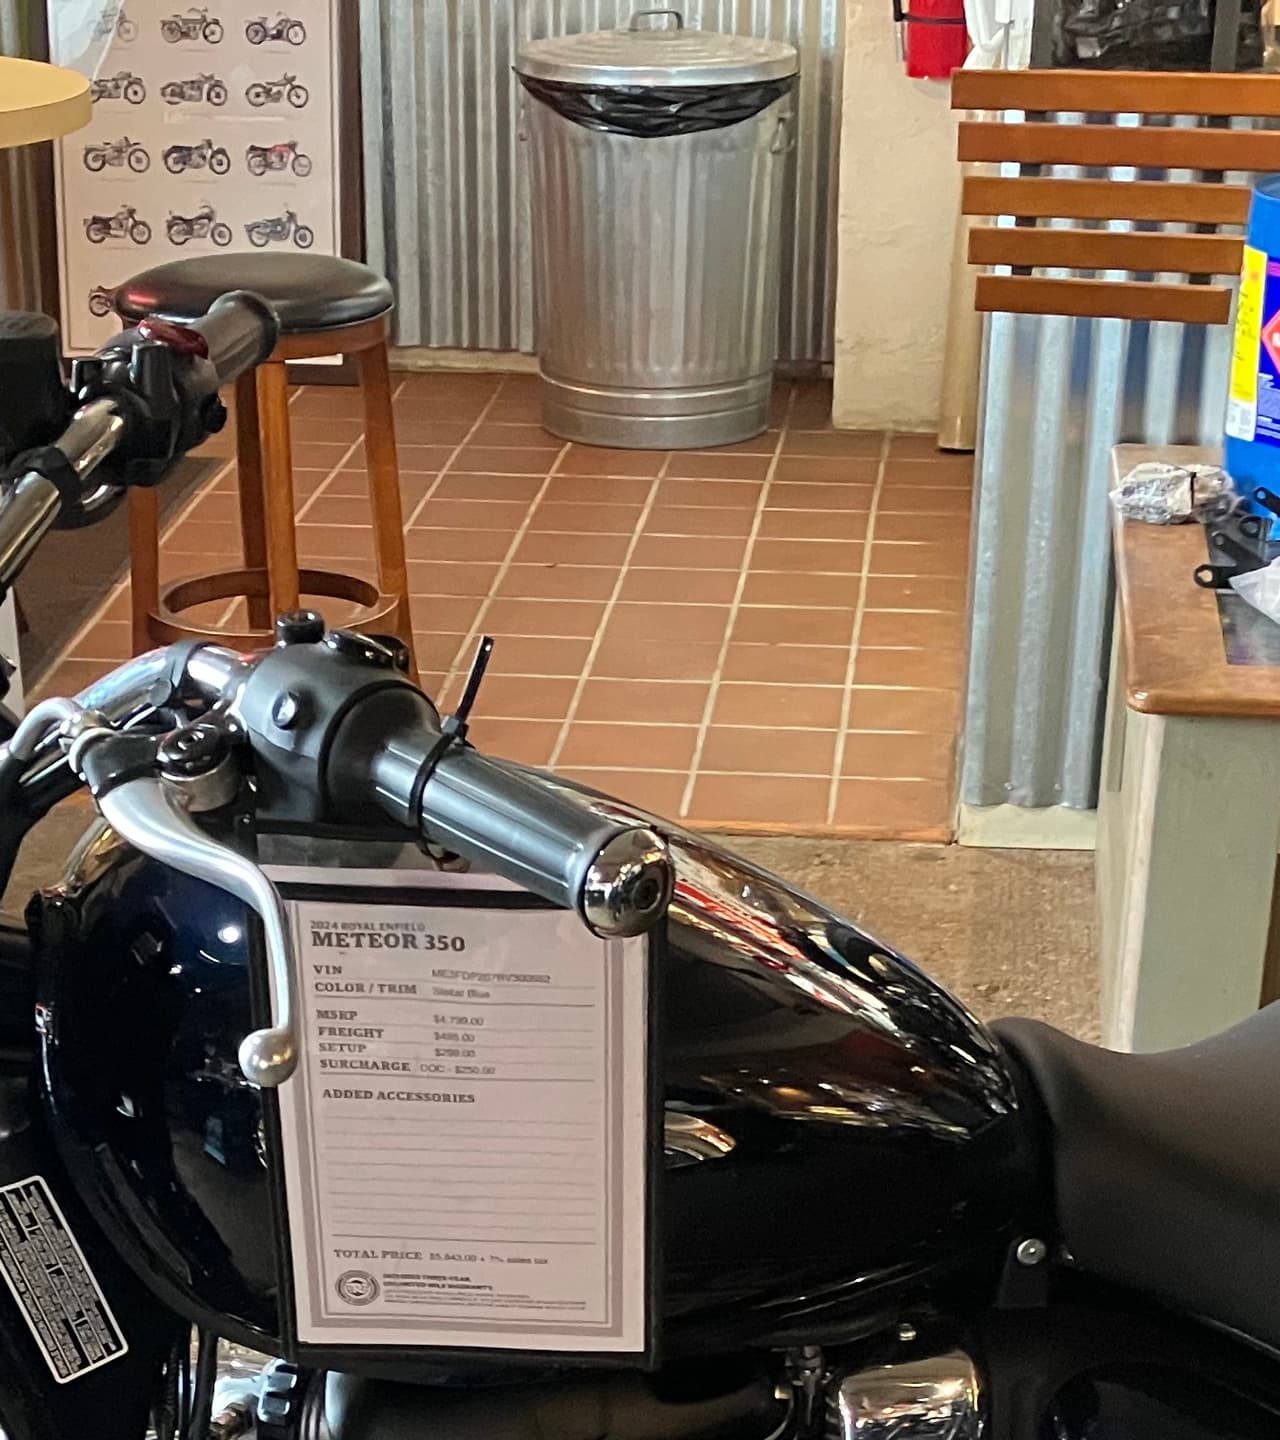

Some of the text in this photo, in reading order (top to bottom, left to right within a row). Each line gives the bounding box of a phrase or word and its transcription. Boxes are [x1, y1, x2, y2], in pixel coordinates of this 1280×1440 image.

[341, 921, 376, 932] ROYAL
[379, 922, 426, 932] ENFIELD
[311, 930, 465, 951] METEOR 350
[313, 964, 343, 975] VIN
[314, 981, 365, 993] COLOR
[377, 983, 418, 995] TRIM
[316, 1009, 358, 1021] MSRP
[318, 1026, 384, 1039] FREIGHT
[319, 1043, 367, 1053] SETUP
[320, 1058, 411, 1071] SURCHARGE
[322, 1088, 476, 1104] ADDED ACCESSORIES
[333, 1249, 379, 1259] TOTAL
[380, 1250, 423, 1260] PRICE
